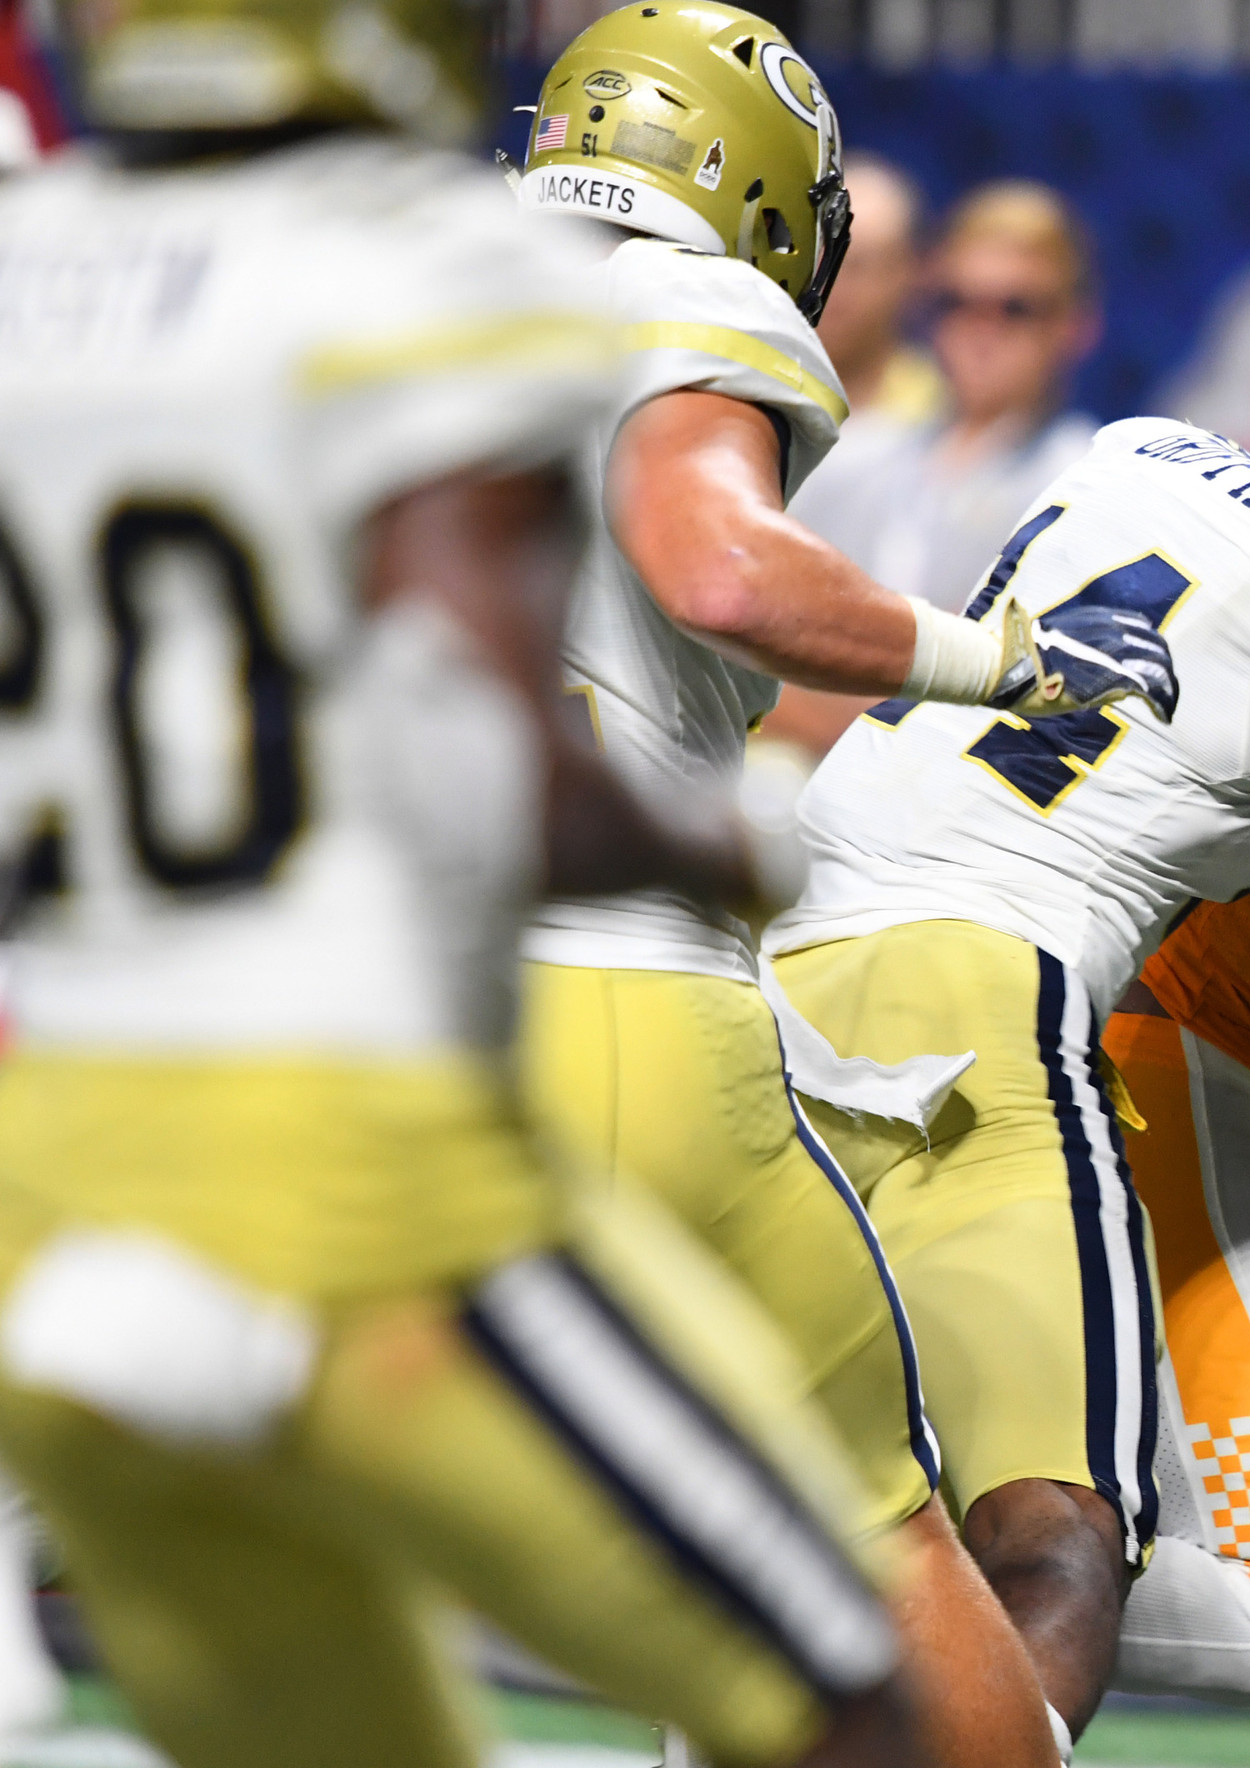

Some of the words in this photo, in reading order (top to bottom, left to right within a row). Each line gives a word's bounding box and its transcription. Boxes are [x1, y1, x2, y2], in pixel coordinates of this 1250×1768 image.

[589, 76, 626, 91] ACC
[581, 133, 598, 158] 51
[537, 176, 635, 214] JACKETS
